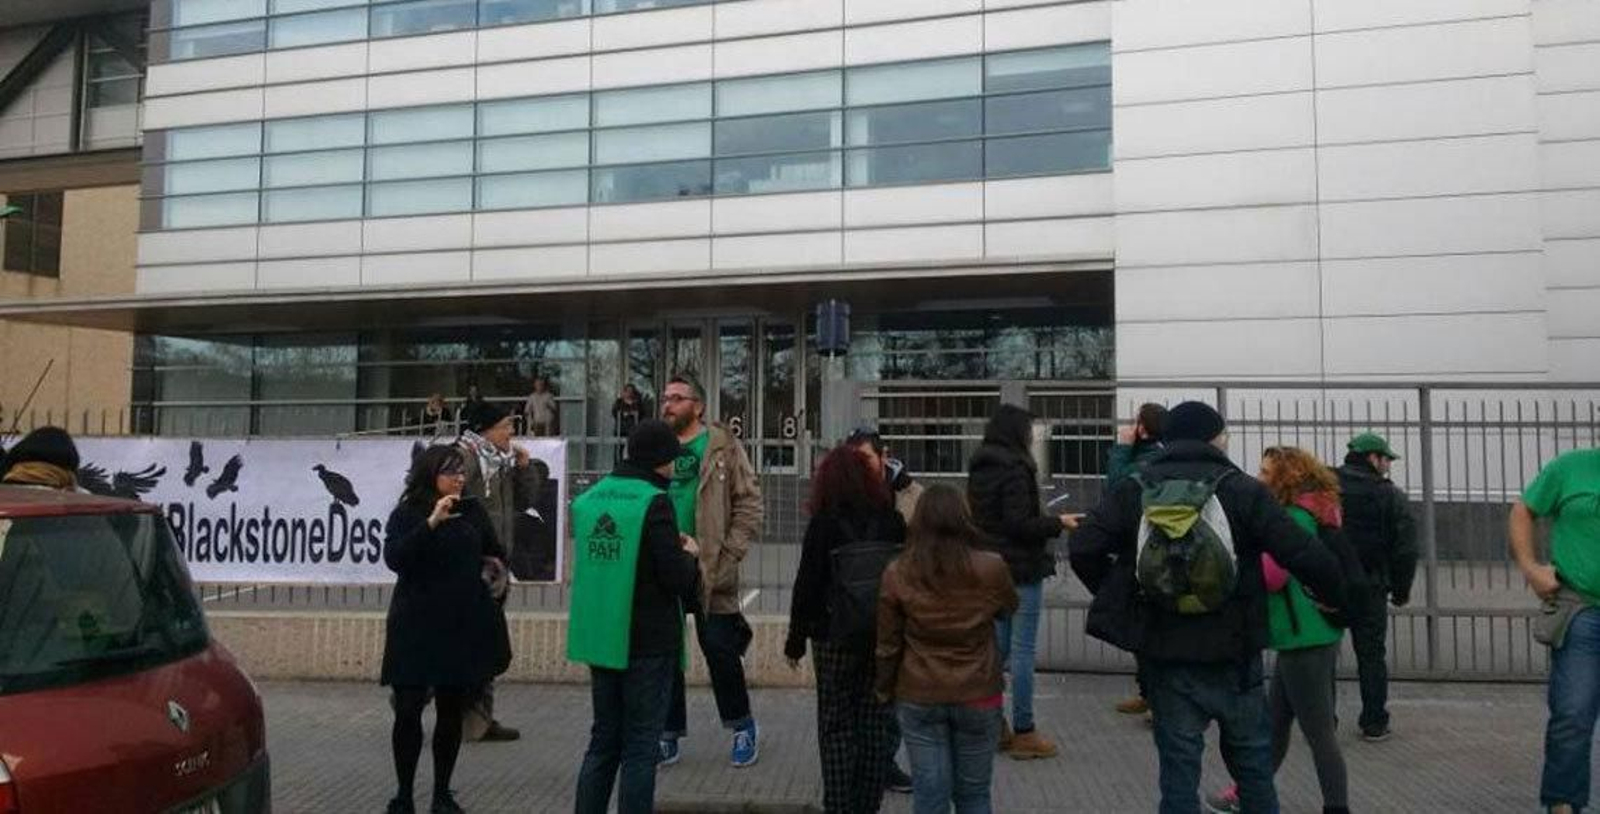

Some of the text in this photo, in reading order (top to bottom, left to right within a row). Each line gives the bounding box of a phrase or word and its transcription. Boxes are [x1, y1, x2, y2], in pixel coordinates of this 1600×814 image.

[729, 416, 742, 438] 6
[783, 416, 797, 438] 8
[160, 501, 382, 564] BlackstoneDes
[587, 540, 622, 561] PAH
